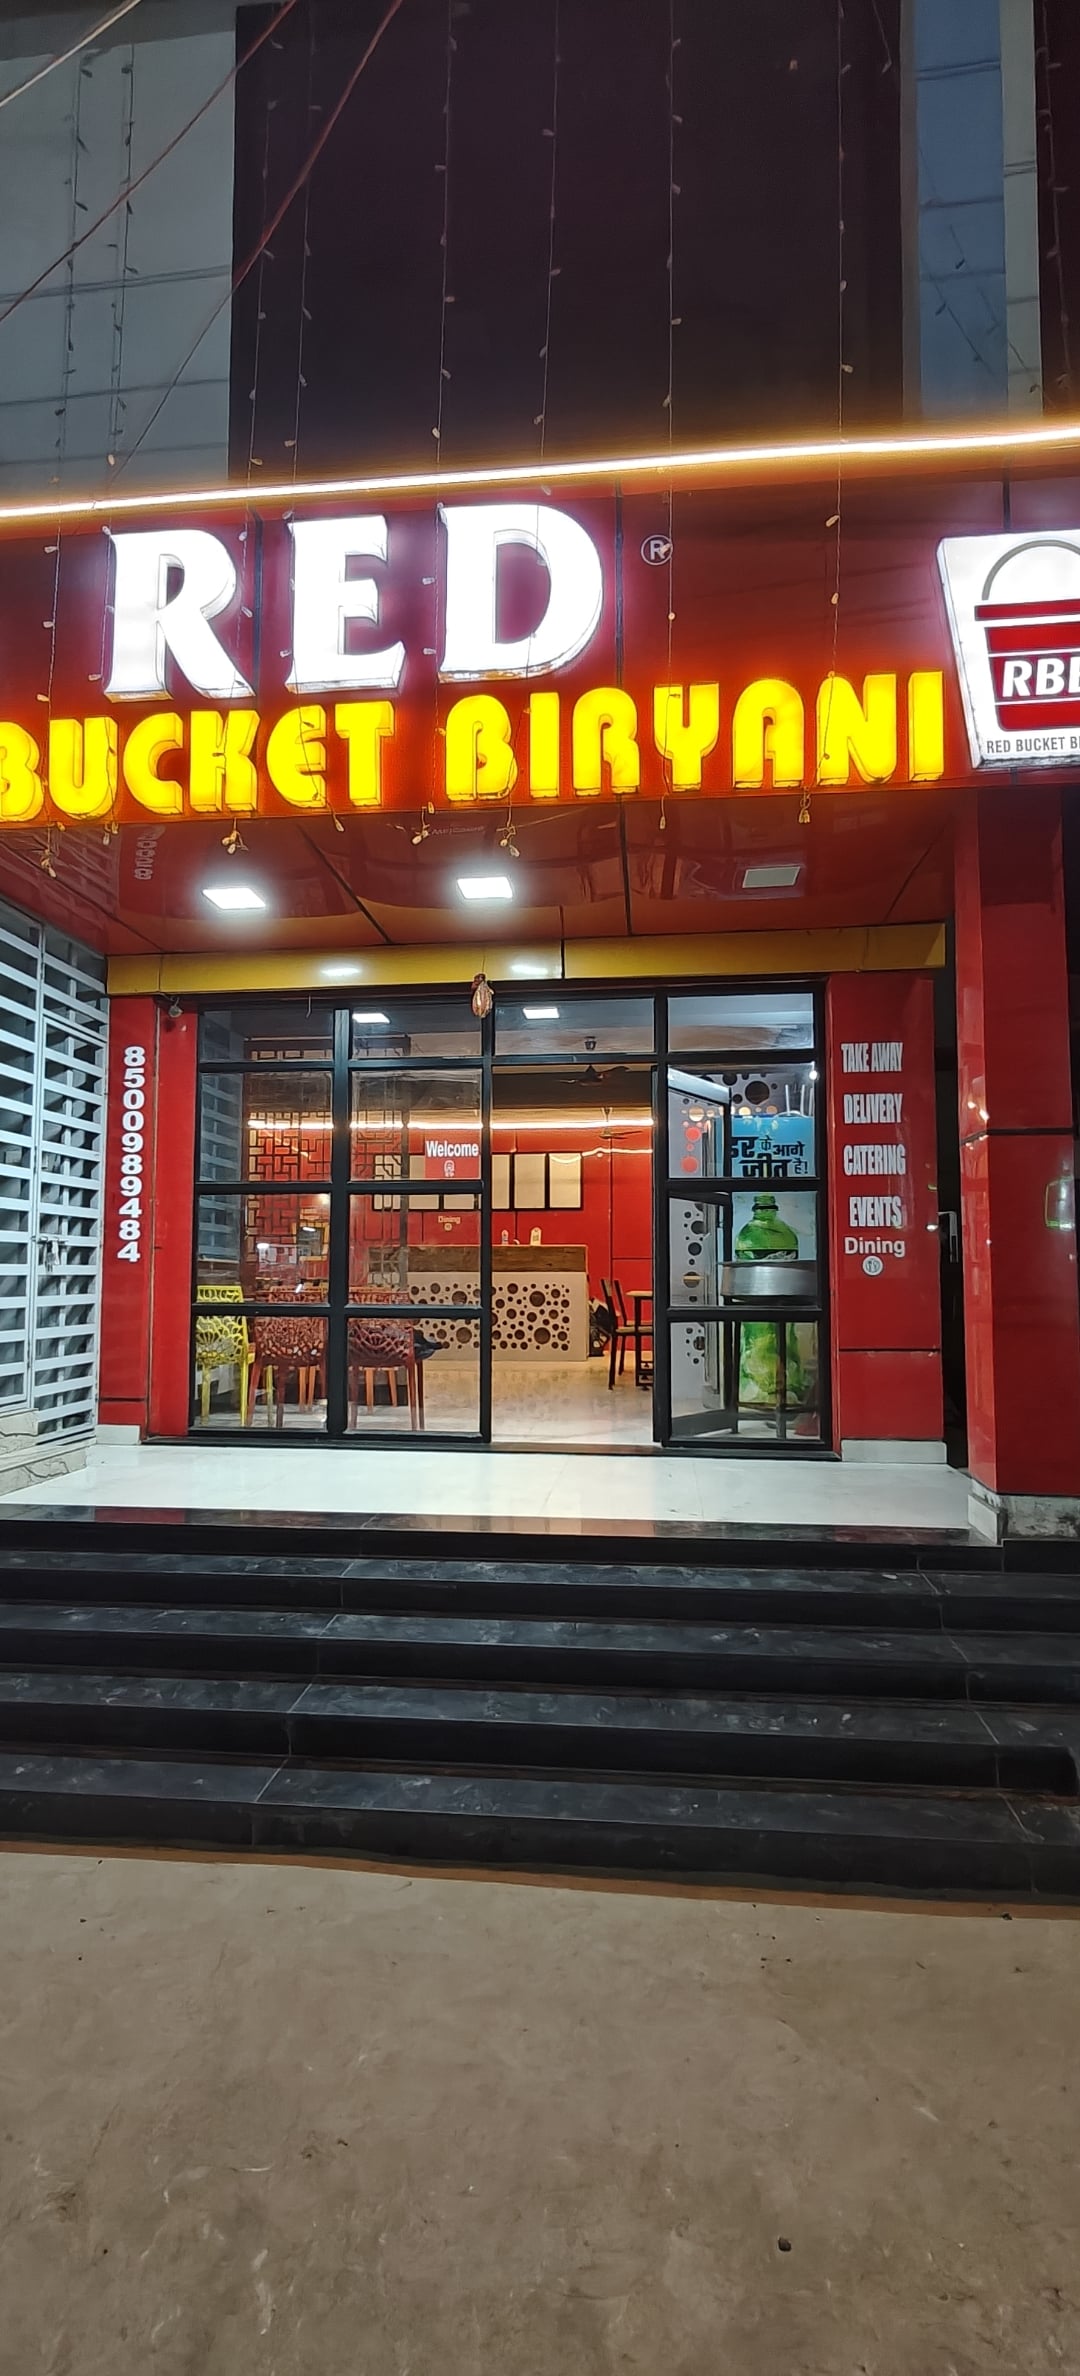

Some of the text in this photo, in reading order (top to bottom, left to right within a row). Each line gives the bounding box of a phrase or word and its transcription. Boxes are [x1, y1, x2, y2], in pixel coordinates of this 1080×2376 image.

[105, 503, 604, 702] RED
[0, 670, 945, 822] BUCKET BIRYANI
[986, 740, 1011, 754] RED
[1016, 736, 1066, 752] BUCKET
[841, 1042, 903, 1073] TAKE AWAY
[843, 1093, 903, 1125] DELIVERY
[117, 1046, 146, 1263] 8500989484
[425, 1140, 480, 1158] Welcome
[843, 1144, 906, 1176] CATERING
[849, 1195, 902, 1229] EVENTS
[844, 1236, 906, 1258] Dining
